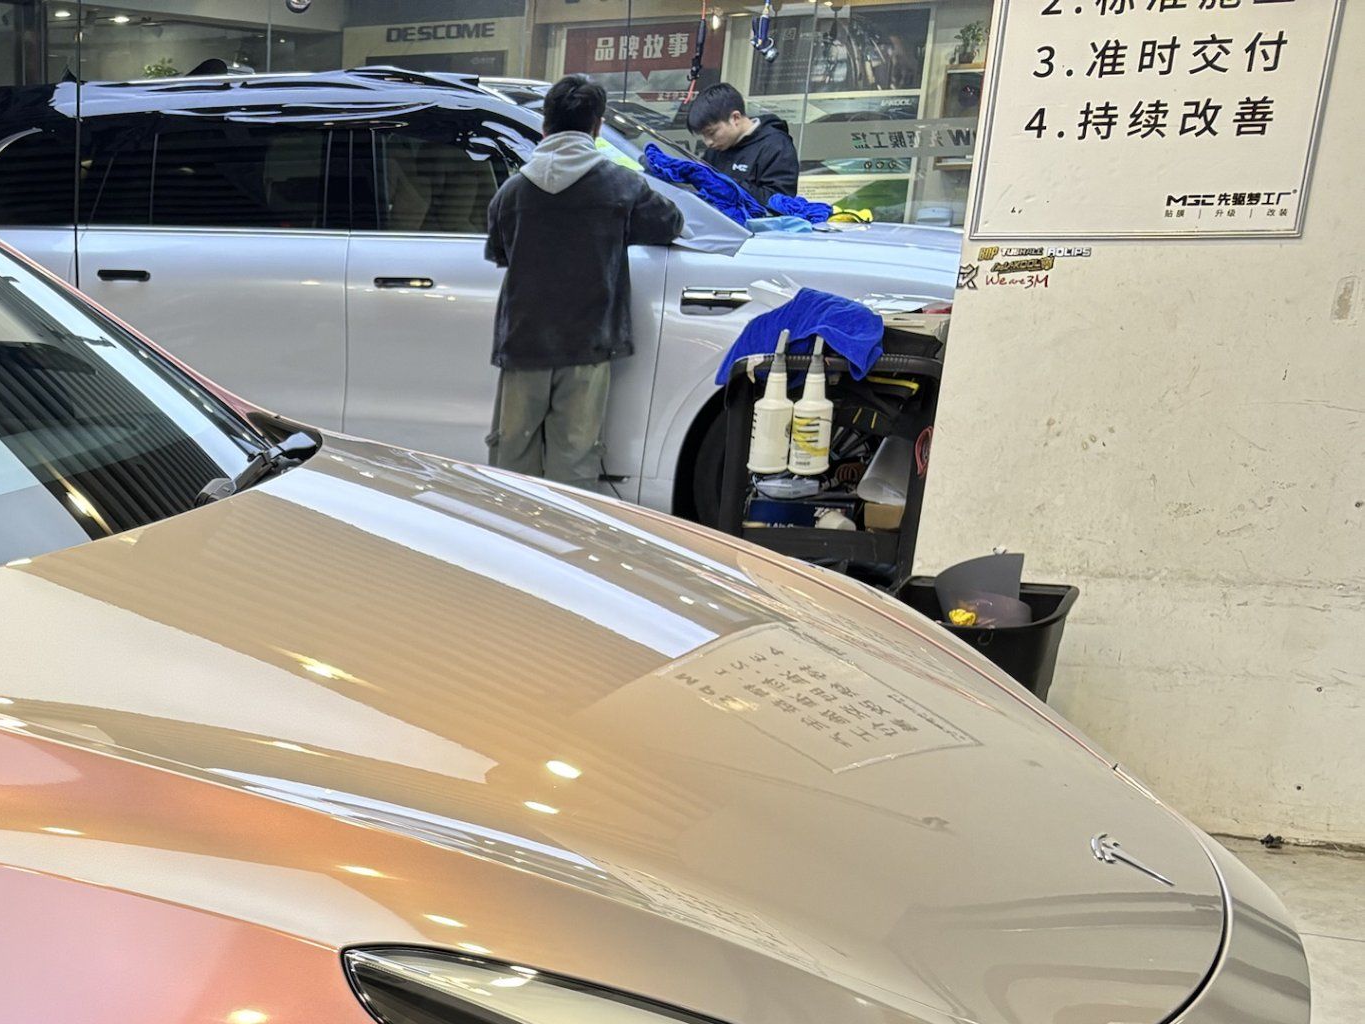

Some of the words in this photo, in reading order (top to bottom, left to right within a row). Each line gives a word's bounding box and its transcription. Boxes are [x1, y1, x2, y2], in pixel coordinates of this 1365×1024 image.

[386, 22, 495, 43] DESCOME
[594, 33, 689, 61] 品牌故事
[1033, 31, 1288, 78] 3.准时交付
[1024, 96, 1274, 140] 4.持续改善
[1024, 274, 1049, 289] 3M
